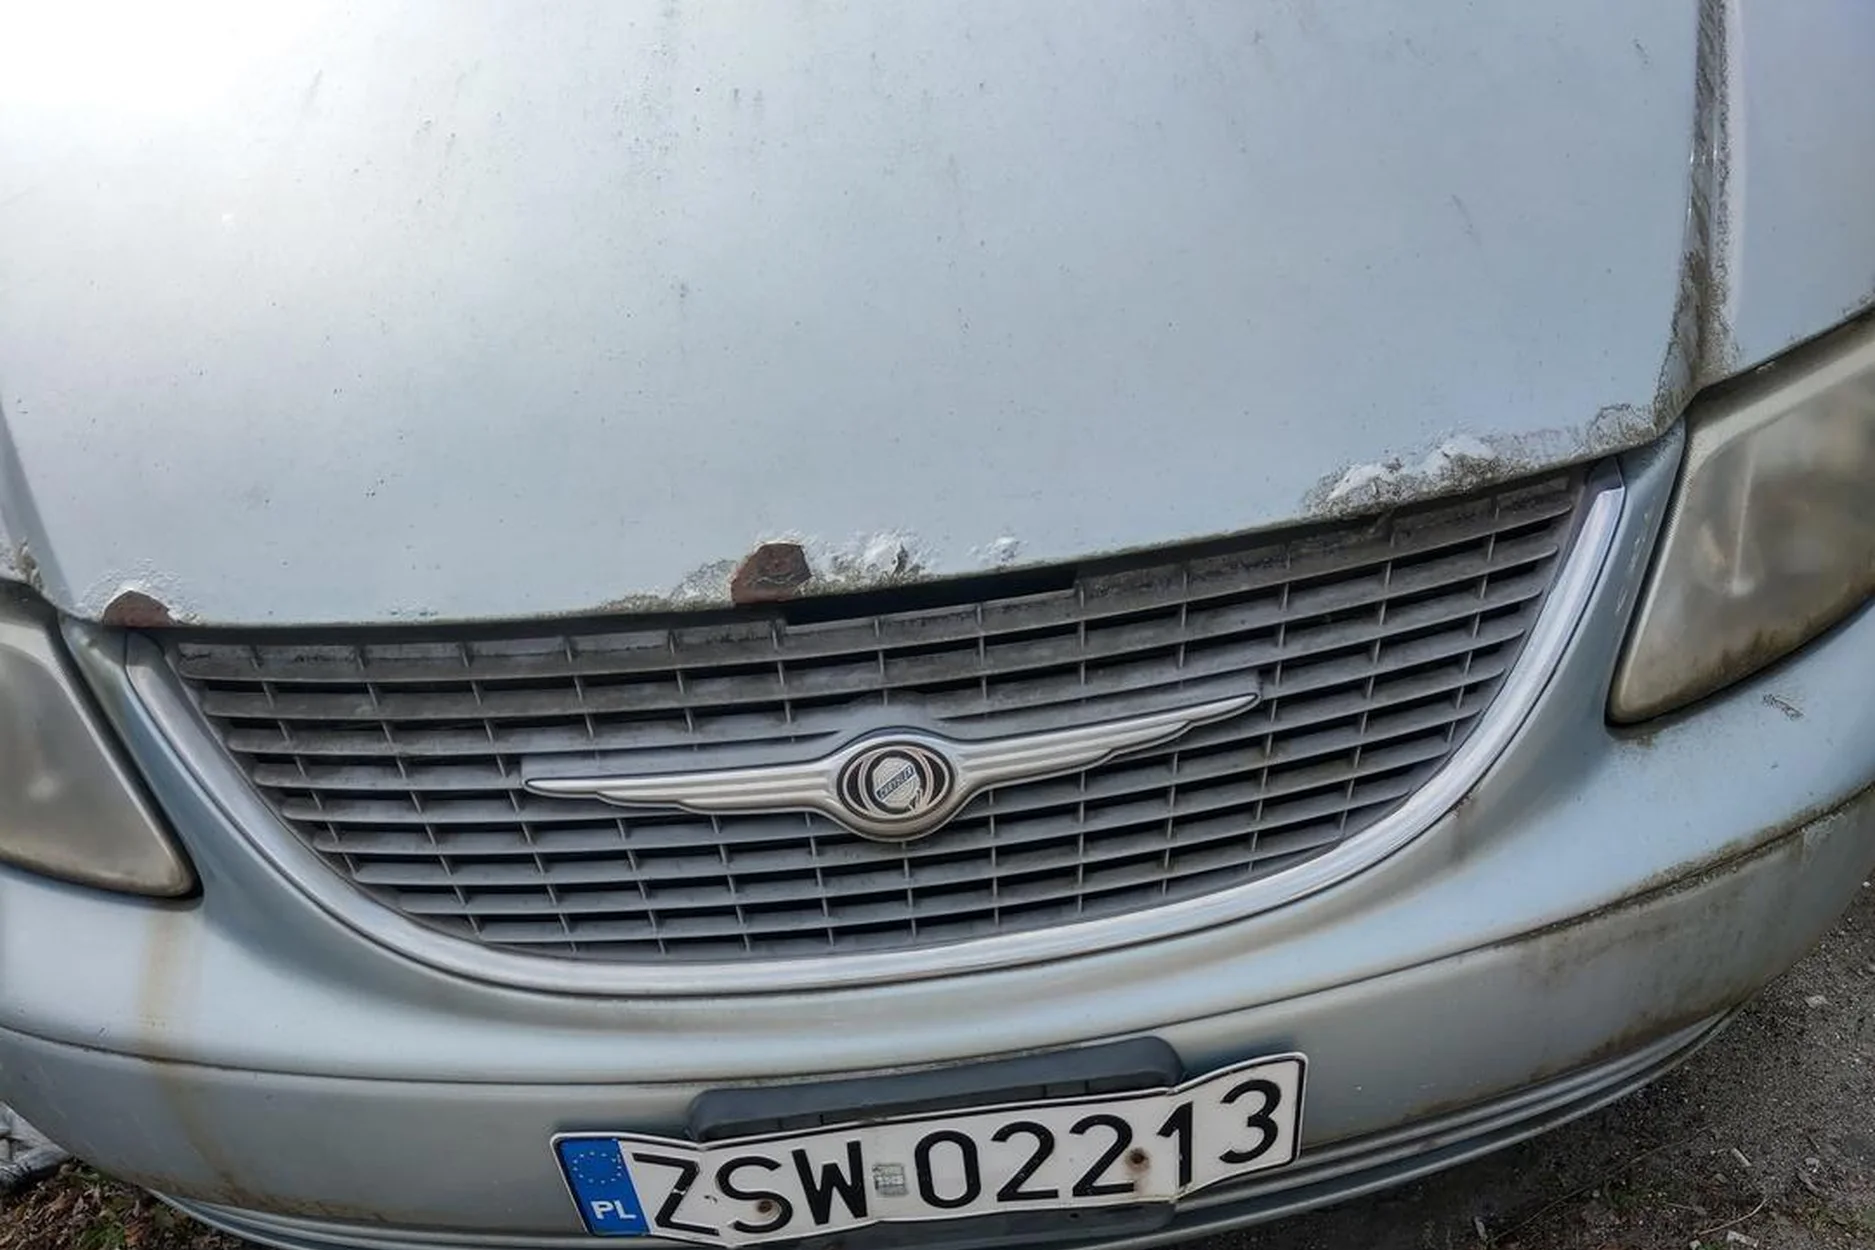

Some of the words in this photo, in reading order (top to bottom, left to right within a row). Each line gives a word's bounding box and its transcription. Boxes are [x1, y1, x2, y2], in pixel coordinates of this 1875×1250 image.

[633, 1140, 868, 1234] ZSW
[914, 1079, 1281, 1208] 02213
[593, 1200, 637, 1220] PL
